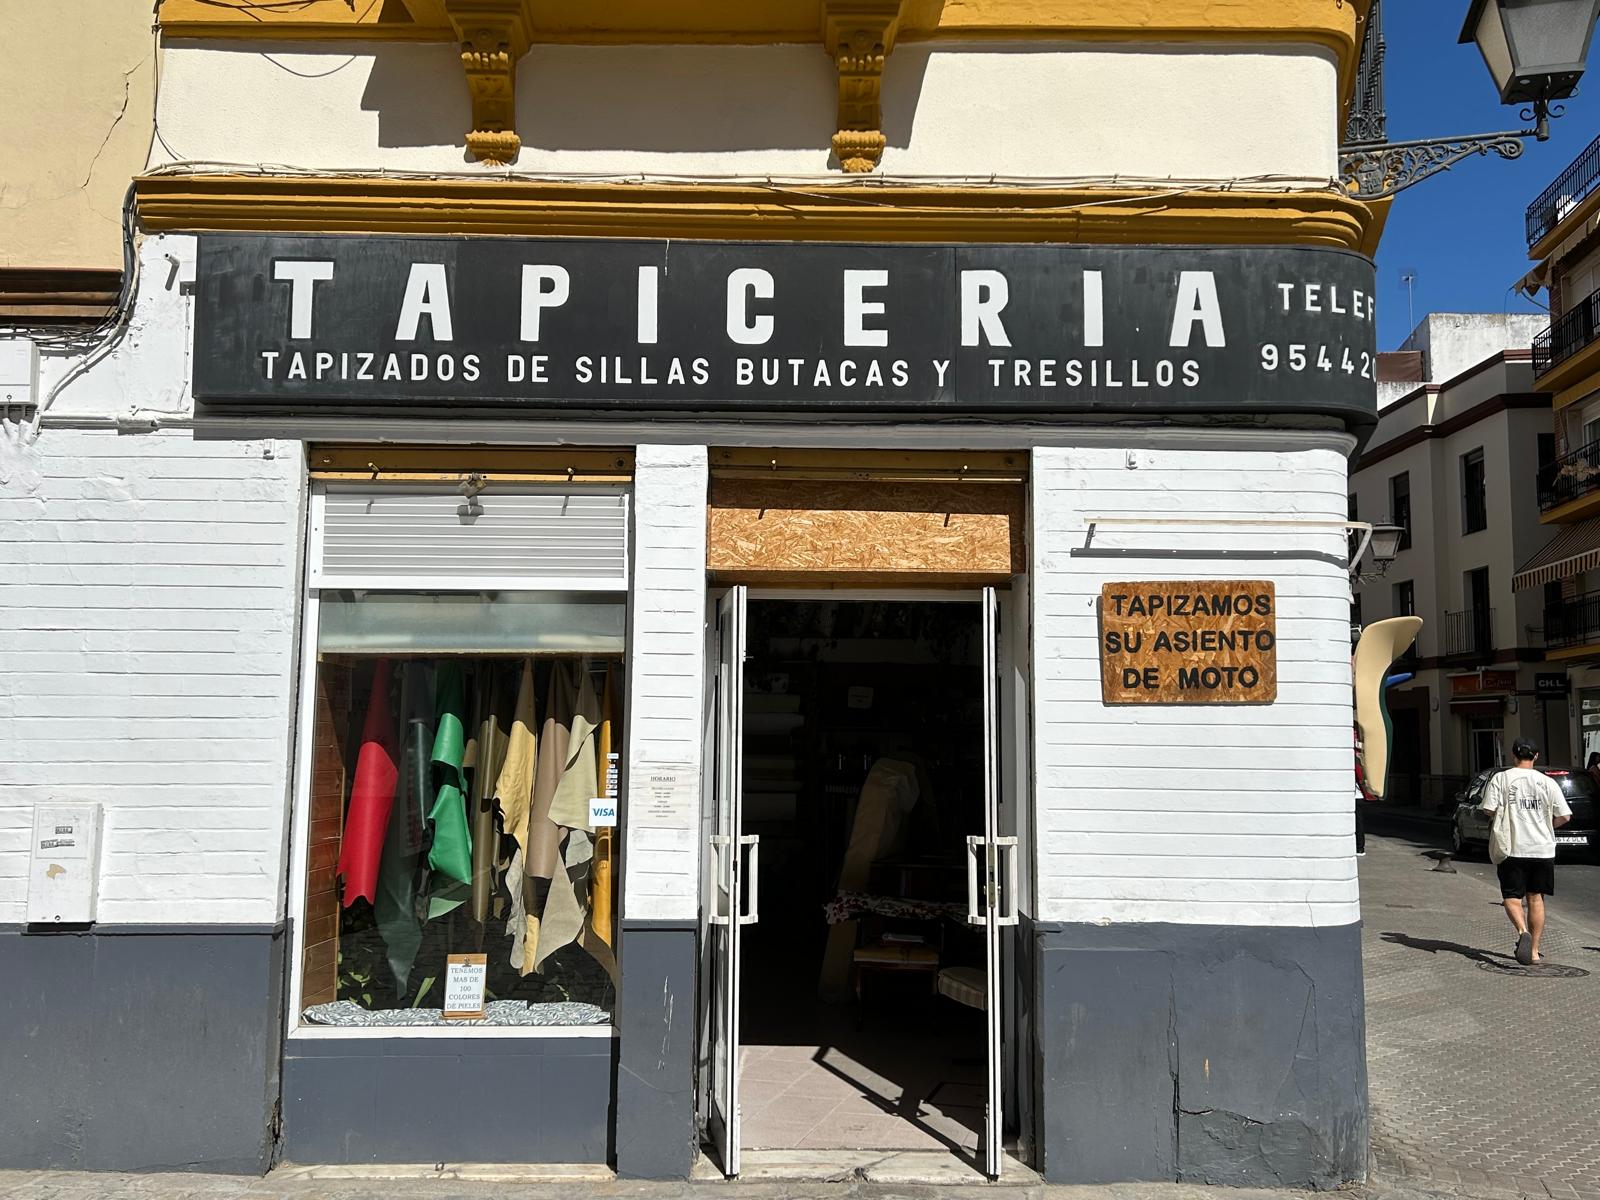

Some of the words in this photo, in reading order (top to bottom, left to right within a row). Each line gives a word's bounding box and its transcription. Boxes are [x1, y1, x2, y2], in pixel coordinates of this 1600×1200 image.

[273, 260, 1226, 349] TAPICERIA
[261, 350, 481, 382] TAPIZADOS
[507, 354, 550, 383] DE
[575, 356, 710, 385] SILLAS
[735, 358, 909, 388] BUTACAS
[931, 360, 951, 388] Y
[988, 359, 1200, 388] TRESILLOS
[1110, 594, 1271, 617] TAPIZAMOS
[1105, 631, 1142, 654] SU
[1153, 629, 1275, 653] ASIENTO
[1122, 667, 1160, 690] DE
[1178, 666, 1259, 690] MOTO
[592, 808, 615, 817] VISA
